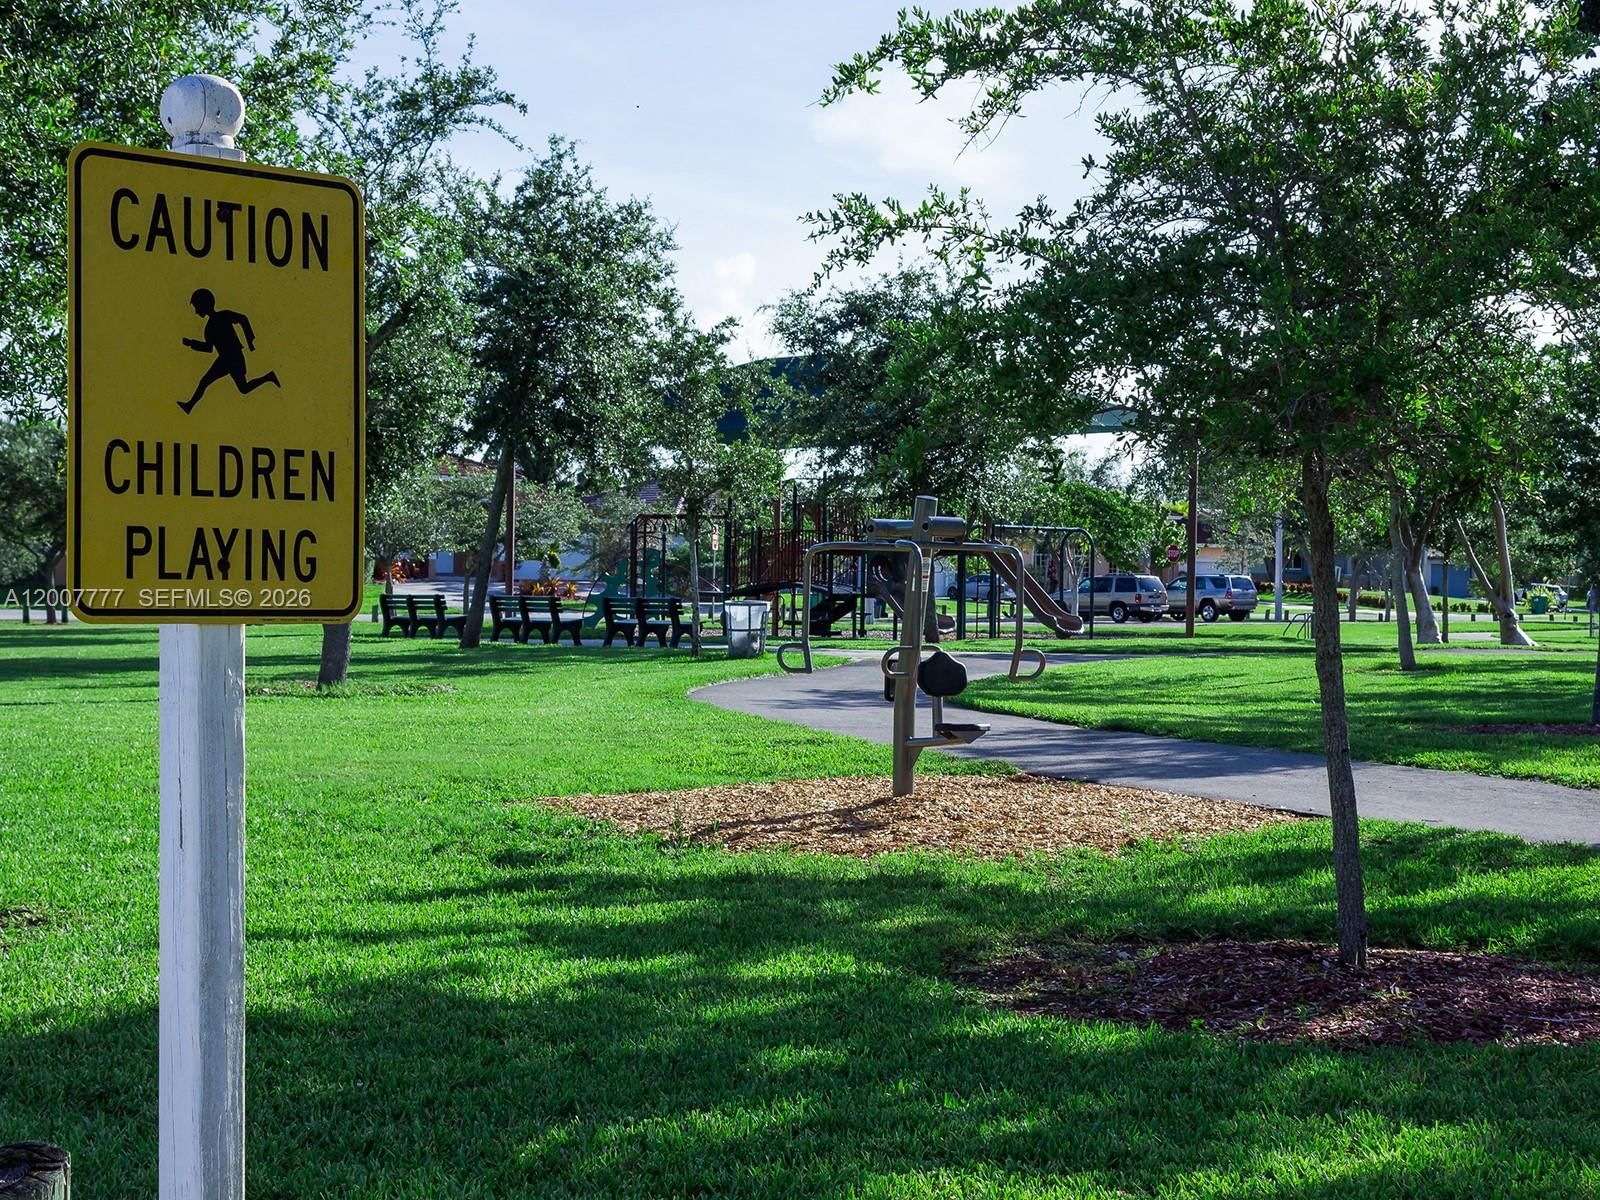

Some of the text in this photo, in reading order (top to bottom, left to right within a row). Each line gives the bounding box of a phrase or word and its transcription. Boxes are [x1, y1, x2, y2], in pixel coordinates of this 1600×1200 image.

[110, 188, 329, 272] CAUTION
[104, 439, 335, 502] CHILDREN
[126, 525, 318, 583] PLAYING
